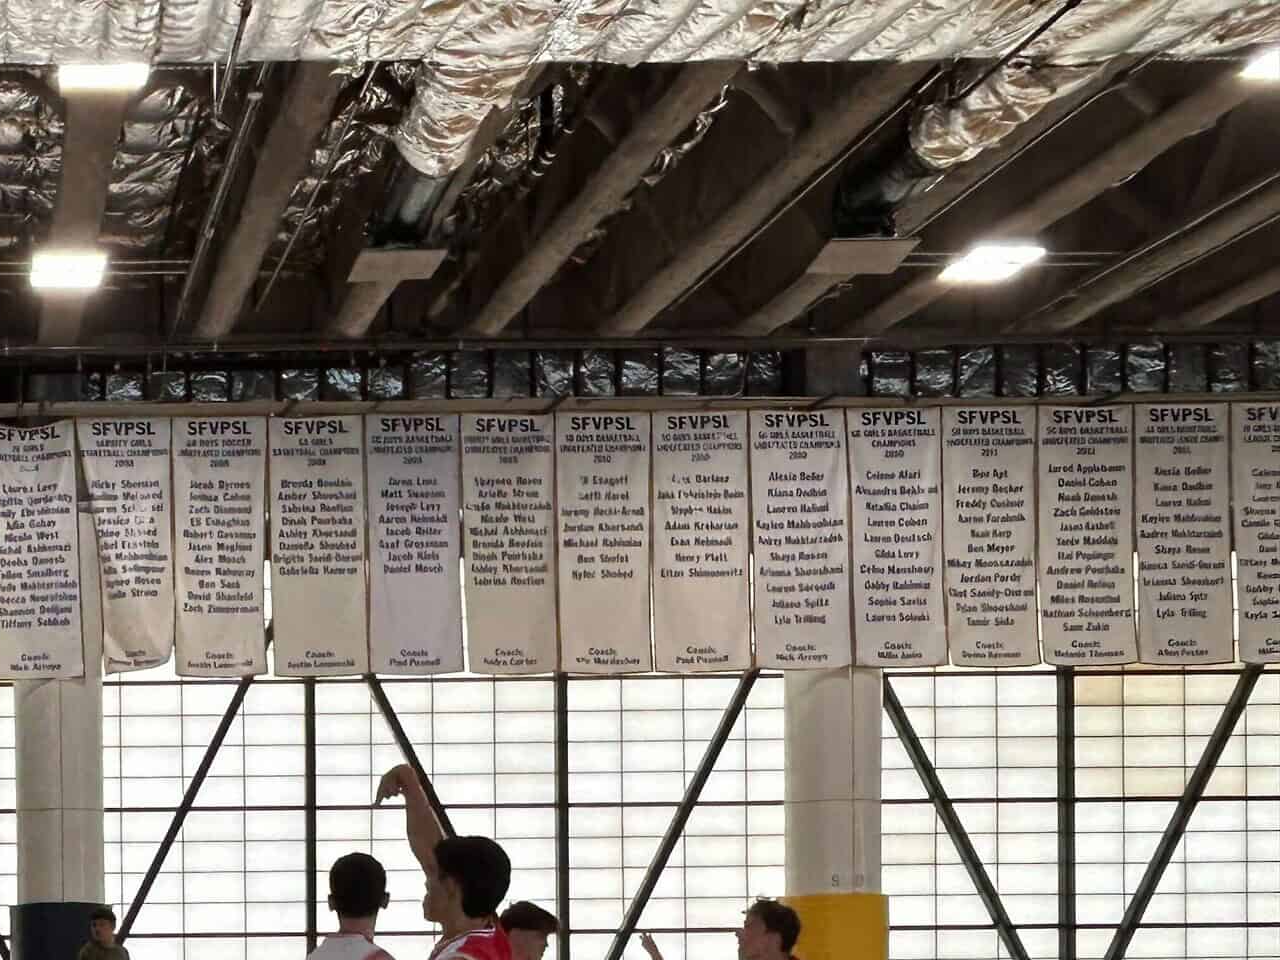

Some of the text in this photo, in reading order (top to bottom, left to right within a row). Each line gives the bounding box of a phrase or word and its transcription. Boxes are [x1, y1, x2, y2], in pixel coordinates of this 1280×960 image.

[765, 414, 829, 427] SFVPSL
[862, 411, 926, 425] SFVPSL
[958, 411, 1021, 424] SFVPSL
[1053, 410, 1118, 423] SFVPSL
[1150, 408, 1213, 422] SFVPSL
[92, 422, 155, 435] SFVPSL
[188, 421, 251, 435] SFVPSL
[284, 418, 348, 434] SFVPSL
[381, 418, 444, 432] SFVPSL
[476, 419, 540, 432] SFVPSL
[571, 417, 635, 430] SFVPSL
[668, 415, 728, 429] SFVPSL
